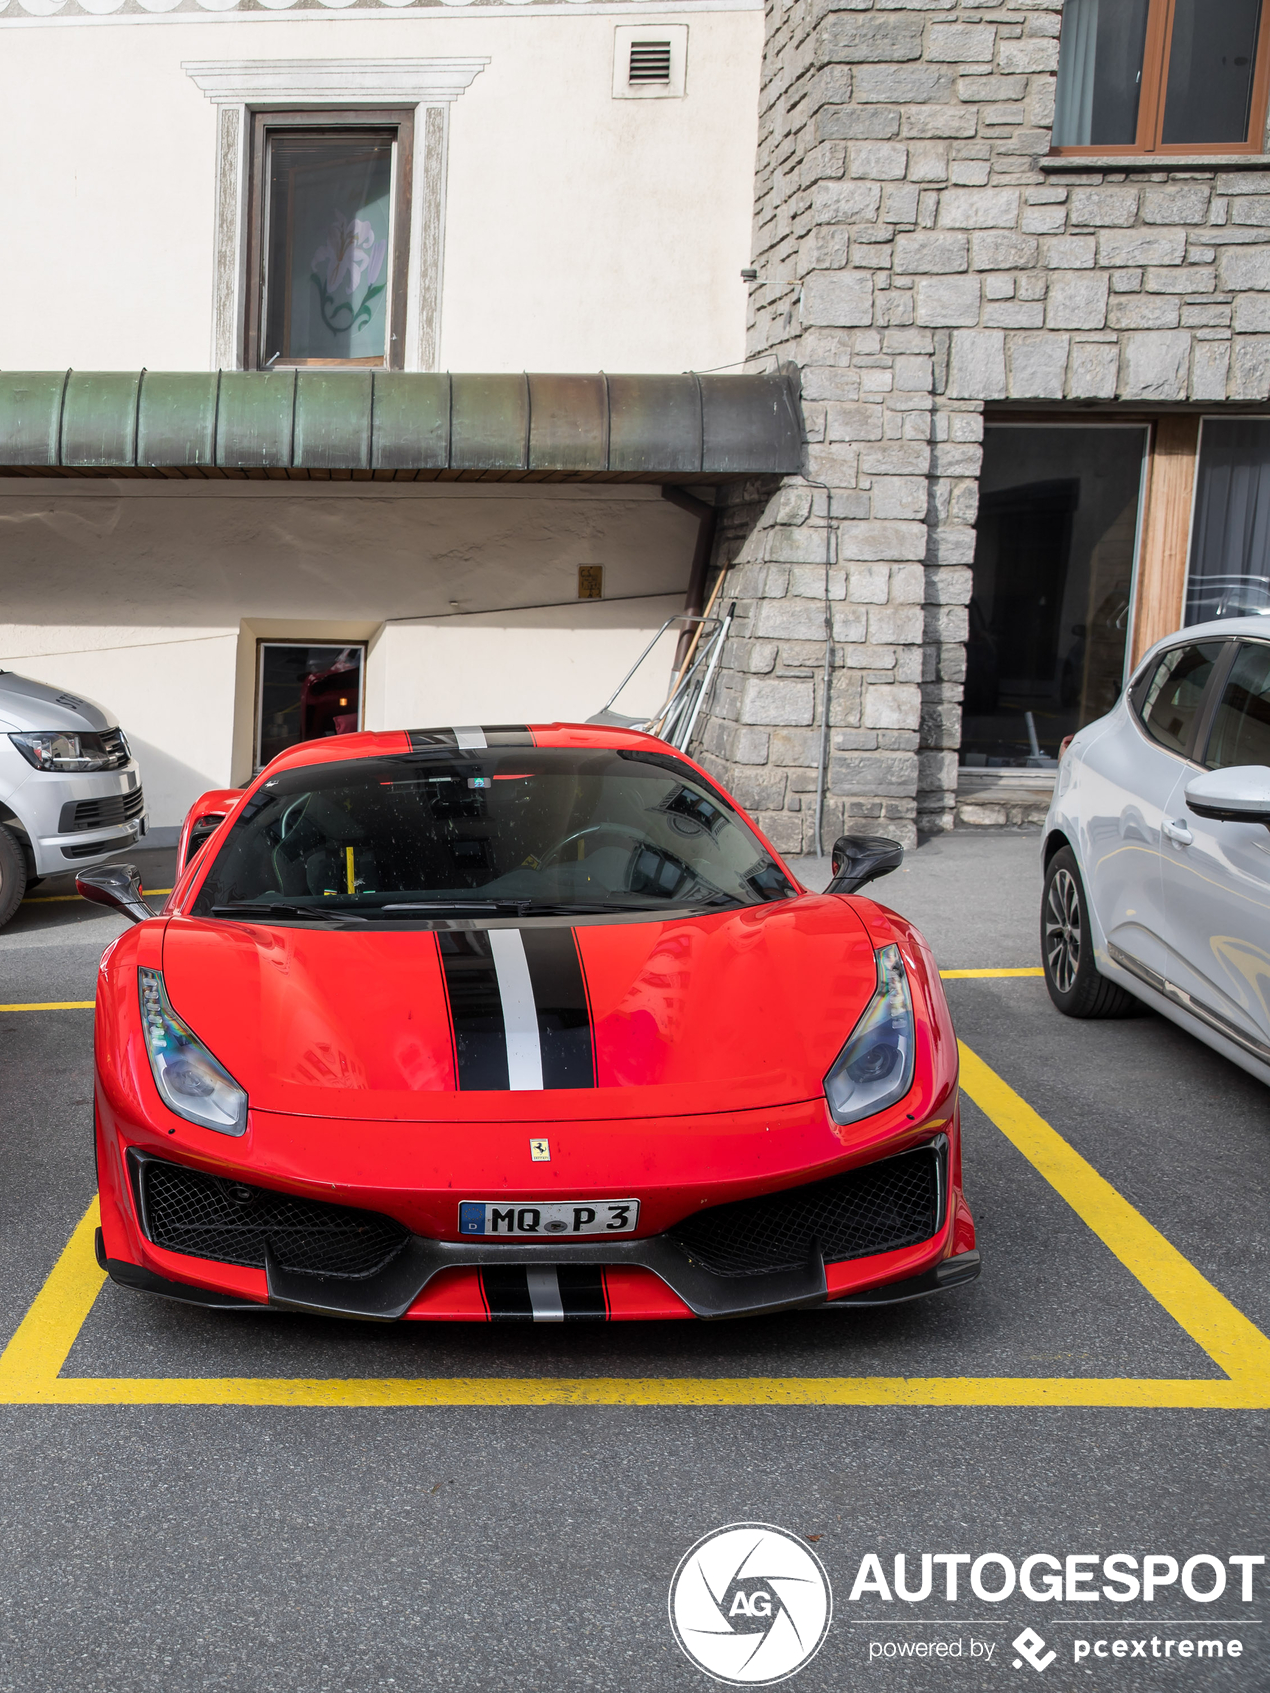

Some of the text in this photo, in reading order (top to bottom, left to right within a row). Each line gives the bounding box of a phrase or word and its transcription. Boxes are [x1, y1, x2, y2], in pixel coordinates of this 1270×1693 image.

[491, 1207, 541, 1232] MQ
[572, 1207, 596, 1232] P
[606, 1205, 631, 1230] 3
